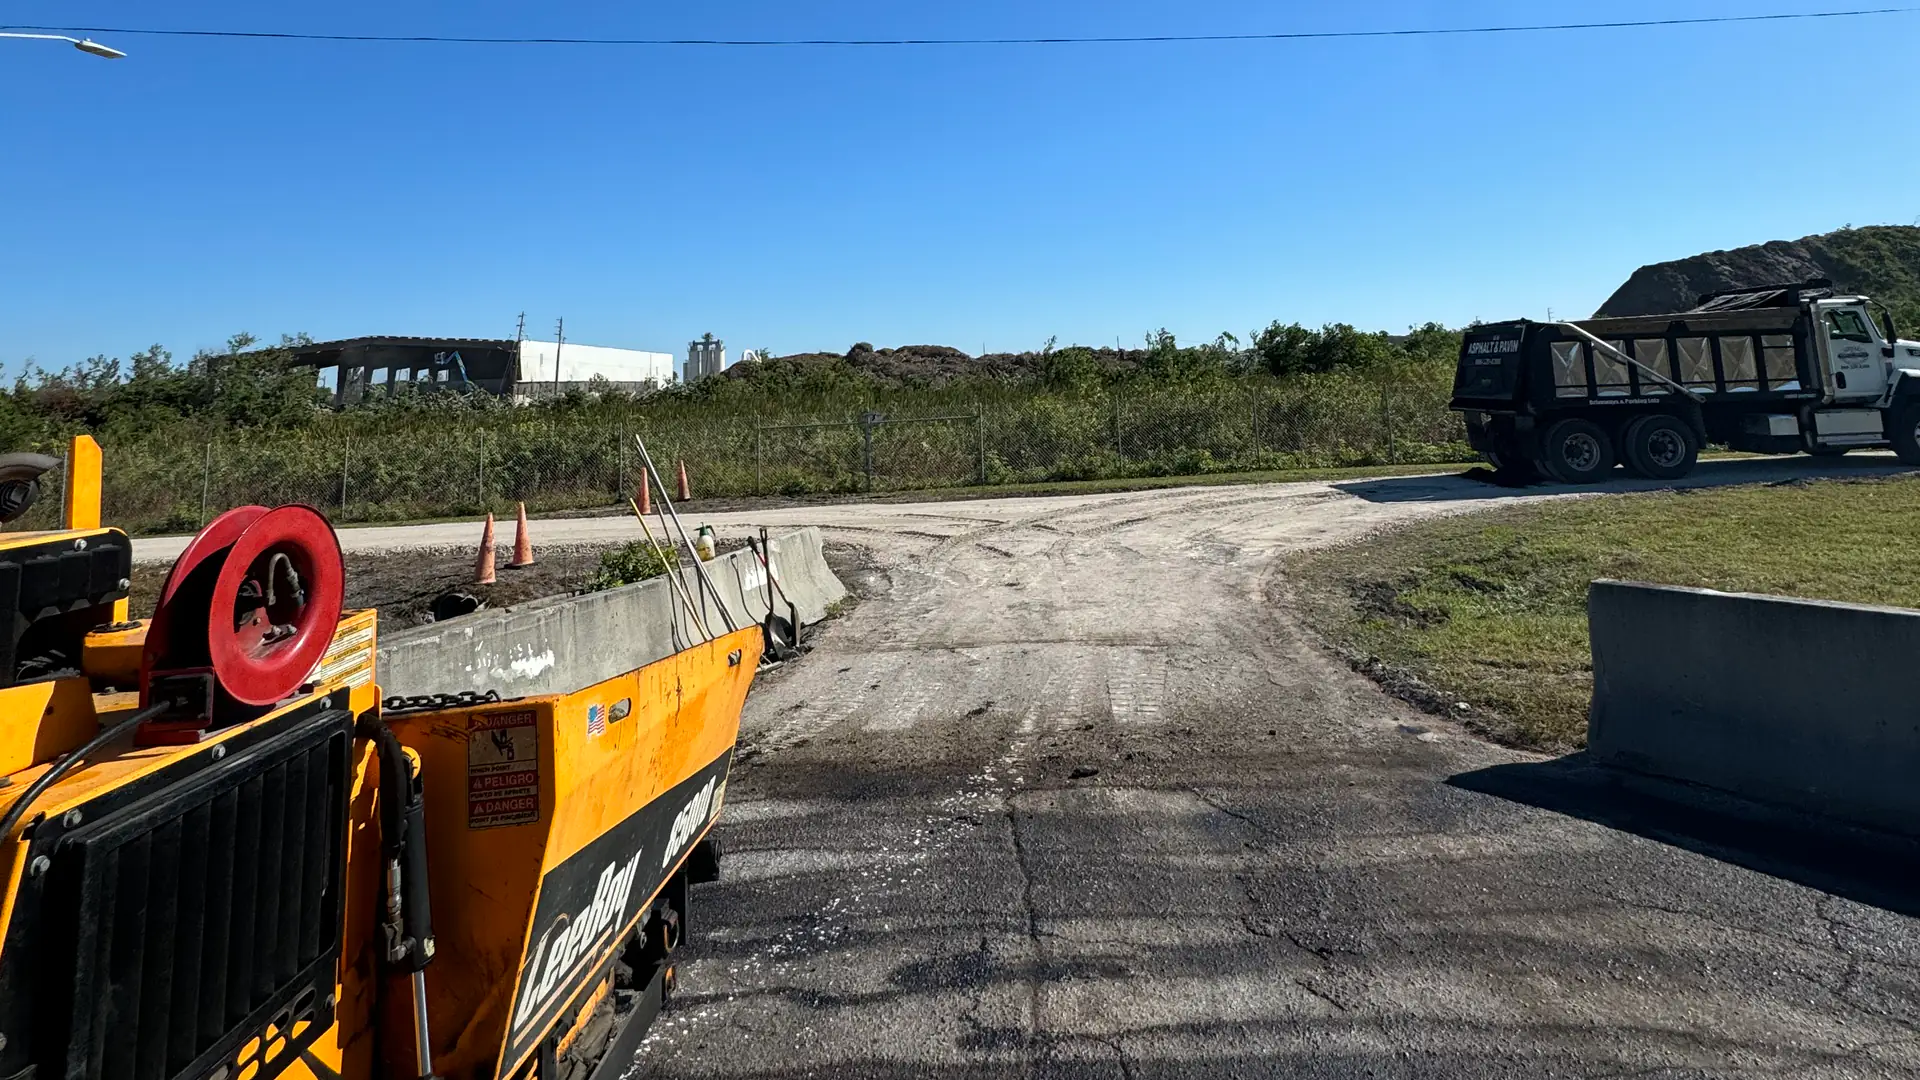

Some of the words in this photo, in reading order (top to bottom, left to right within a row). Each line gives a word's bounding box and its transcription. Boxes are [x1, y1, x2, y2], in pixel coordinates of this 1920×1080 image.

[1467, 341, 1494, 355] ASPHALT
[1493, 341, 1499, 354] &
[484, 773, 534, 789] PELIGRO
[486, 797, 534, 813] DANGER
[513, 848, 643, 1032] LeeBoy
